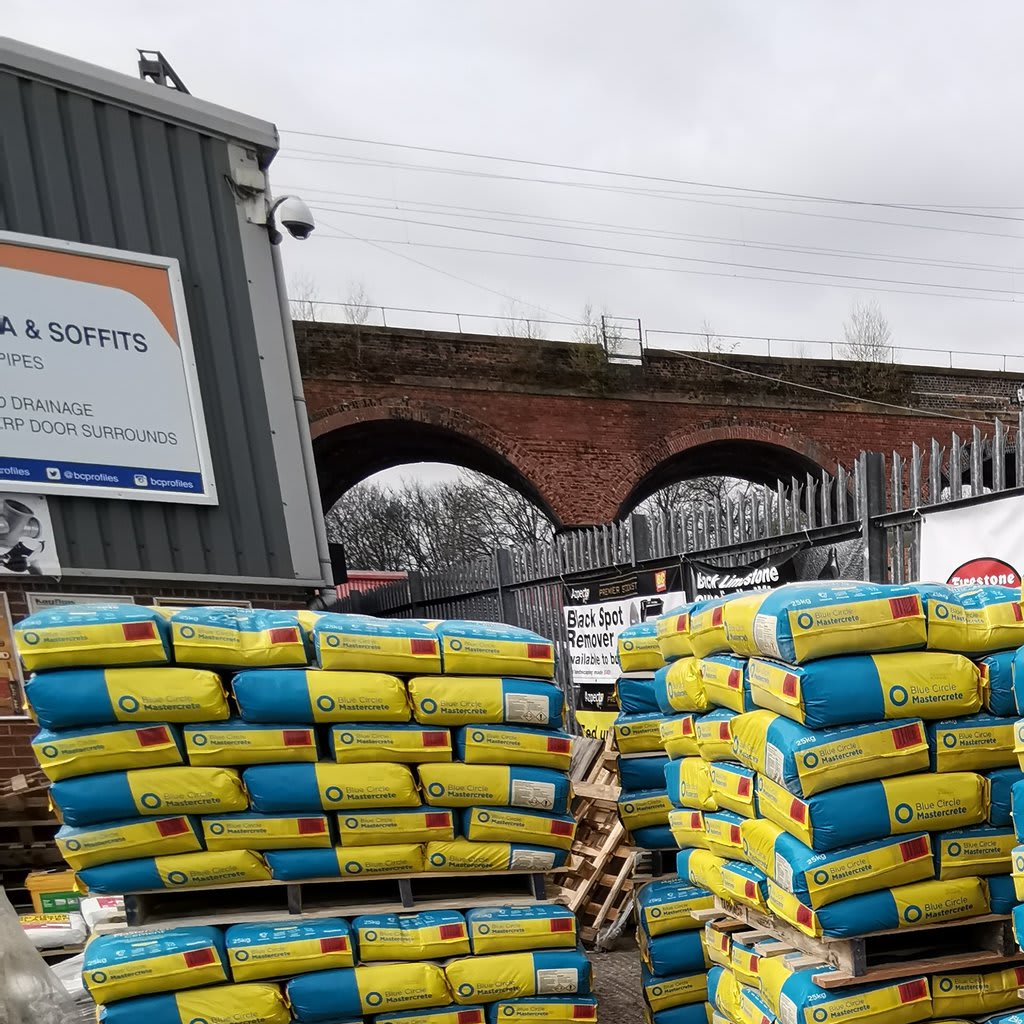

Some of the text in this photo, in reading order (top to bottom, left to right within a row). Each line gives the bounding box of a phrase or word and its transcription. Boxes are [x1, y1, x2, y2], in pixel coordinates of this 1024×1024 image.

[25, 318, 42, 341] &
[48, 321, 148, 353] SOFFITS
[11, 396, 94, 417] DRAINAGE
[0, 417, 178, 445] RP DOOR SURROUNDS
[64, 470, 119, 483] @bcprofiles
[150, 477, 194, 489] bcprofiles
[952, 573, 1015, 586] Firestone
[567, 606, 623, 630] Black Spot
[814, 608, 852, 619] Blue Circle
[816, 615, 859, 626] Mastercrete
[567, 628, 615, 649] Remover
[602, 652, 608, 665] to
[910, 683, 956, 695] Blue Circle
[912, 692, 963, 703] Mastercrete
[346, 792, 396, 800] Mastercrete
[915, 798, 960, 811] Blue Circle
[917, 806, 966, 820] Mastercrete
[924, 896, 967, 911] Blue Circle
[925, 904, 973, 918] Mastercrete
[386, 992, 432, 1002] Mastercrete
